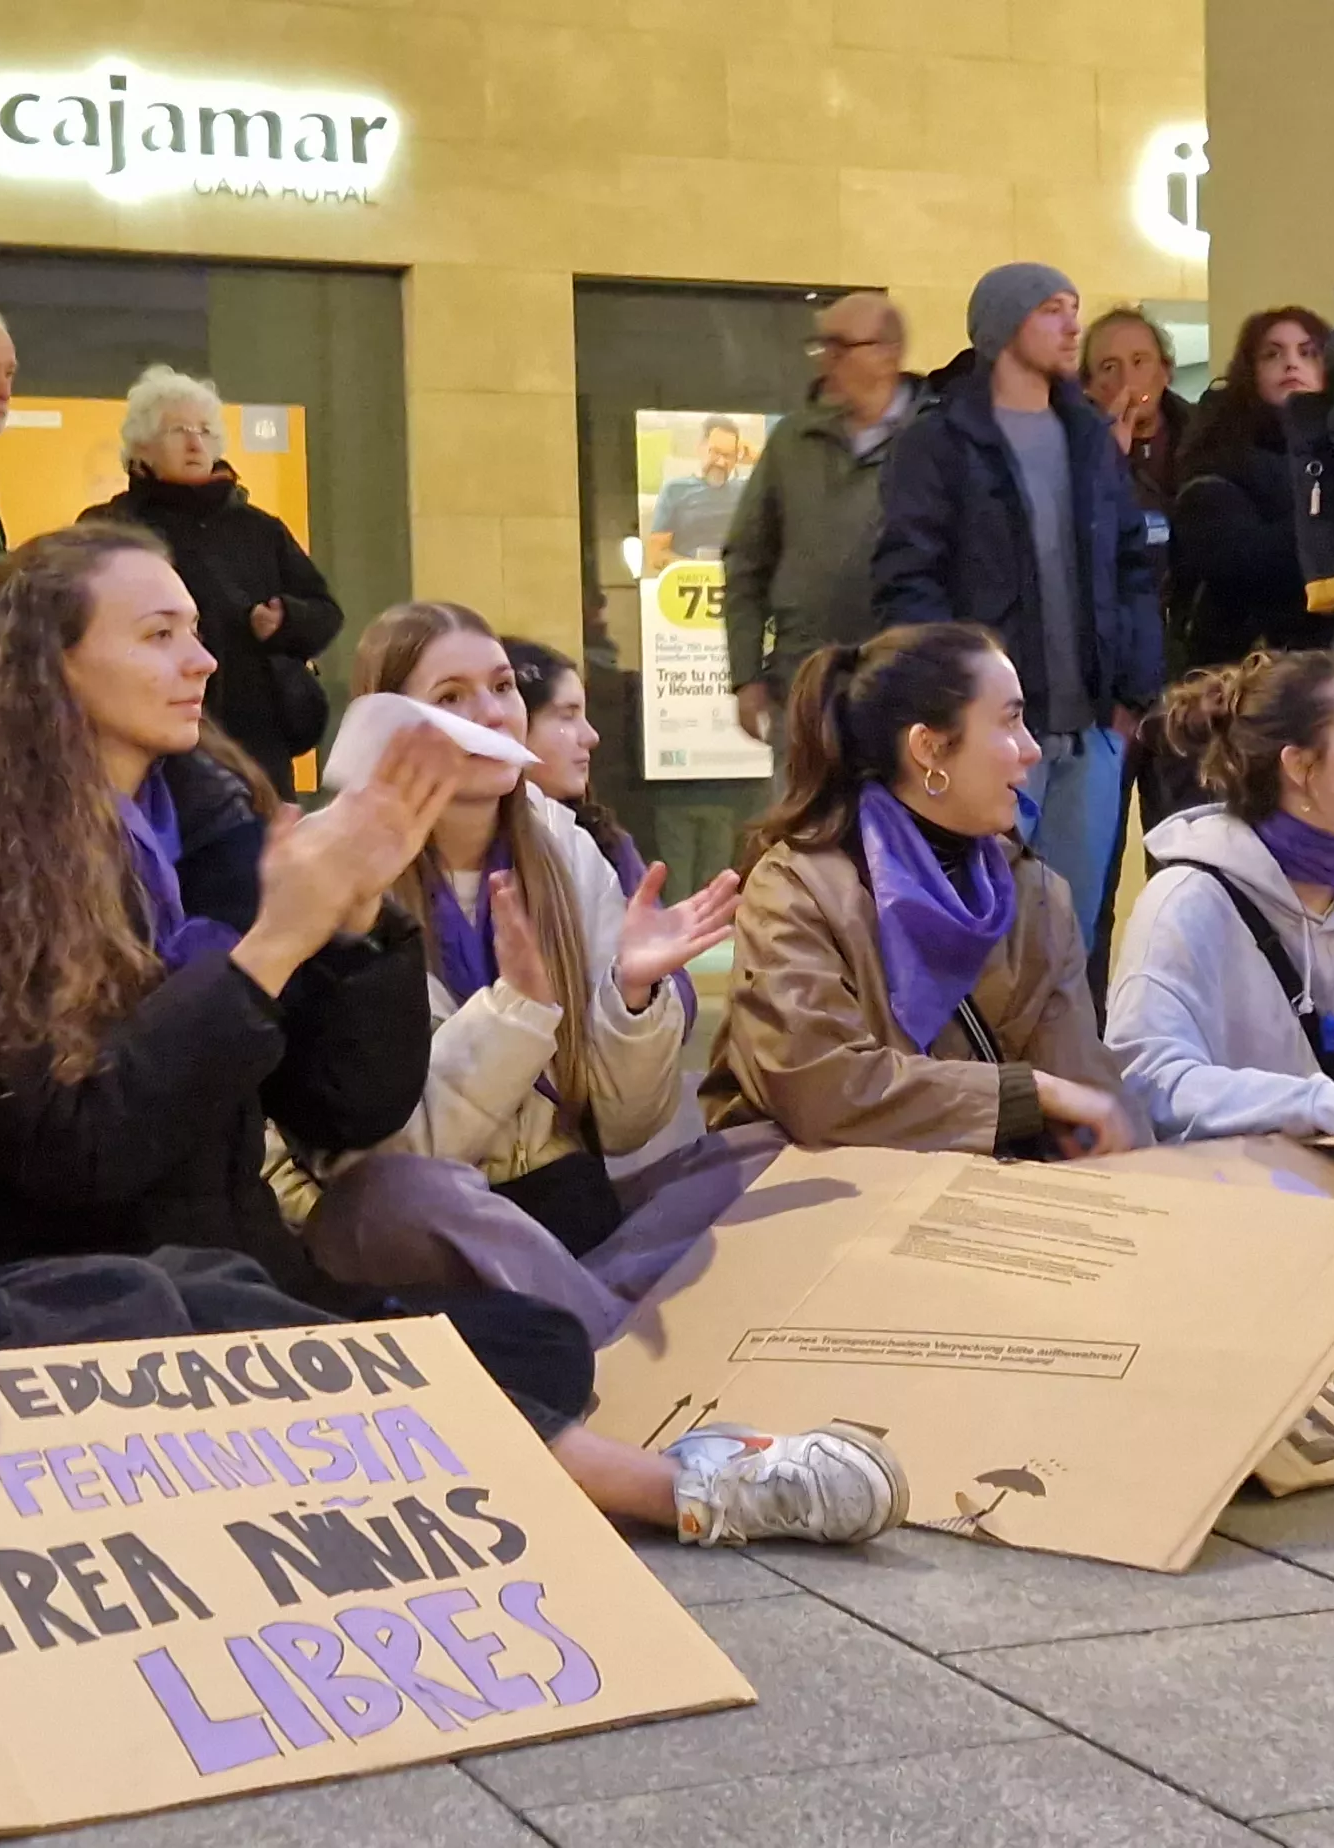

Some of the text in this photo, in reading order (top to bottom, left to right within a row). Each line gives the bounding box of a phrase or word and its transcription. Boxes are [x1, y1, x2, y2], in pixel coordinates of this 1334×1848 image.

[0, 75, 388, 176] cajamar
[193, 177, 269, 200] CAJA
[656, 668, 688, 682] Trae
[691, 669, 706, 682] tu
[656, 685, 666, 699] y
[223, 1487, 527, 1607] NIÑAS
[132, 1579, 603, 1776] LIBRES
